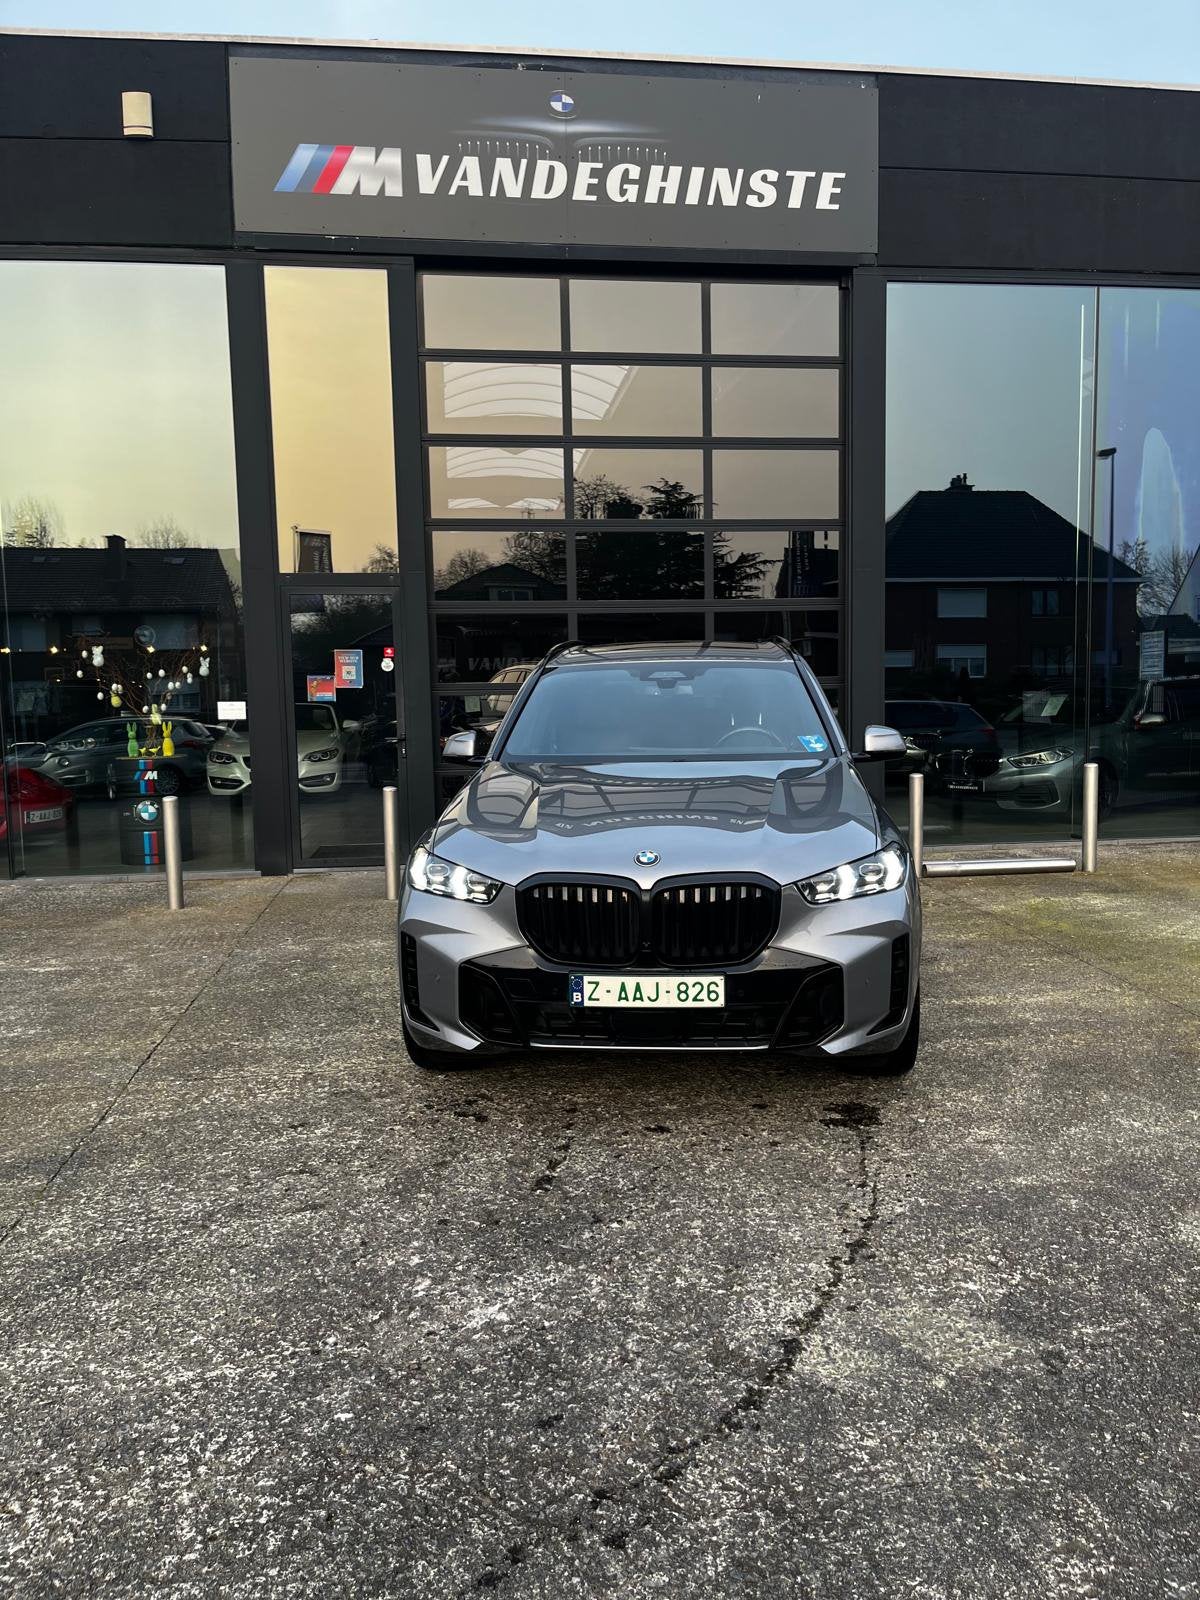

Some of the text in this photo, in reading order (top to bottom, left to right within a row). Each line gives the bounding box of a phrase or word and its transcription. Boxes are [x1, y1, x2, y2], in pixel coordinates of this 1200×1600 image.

[329, 145, 847, 210] M VANDEGHINSTE
[573, 981, 720, 1003] B Z-AAJ-826
